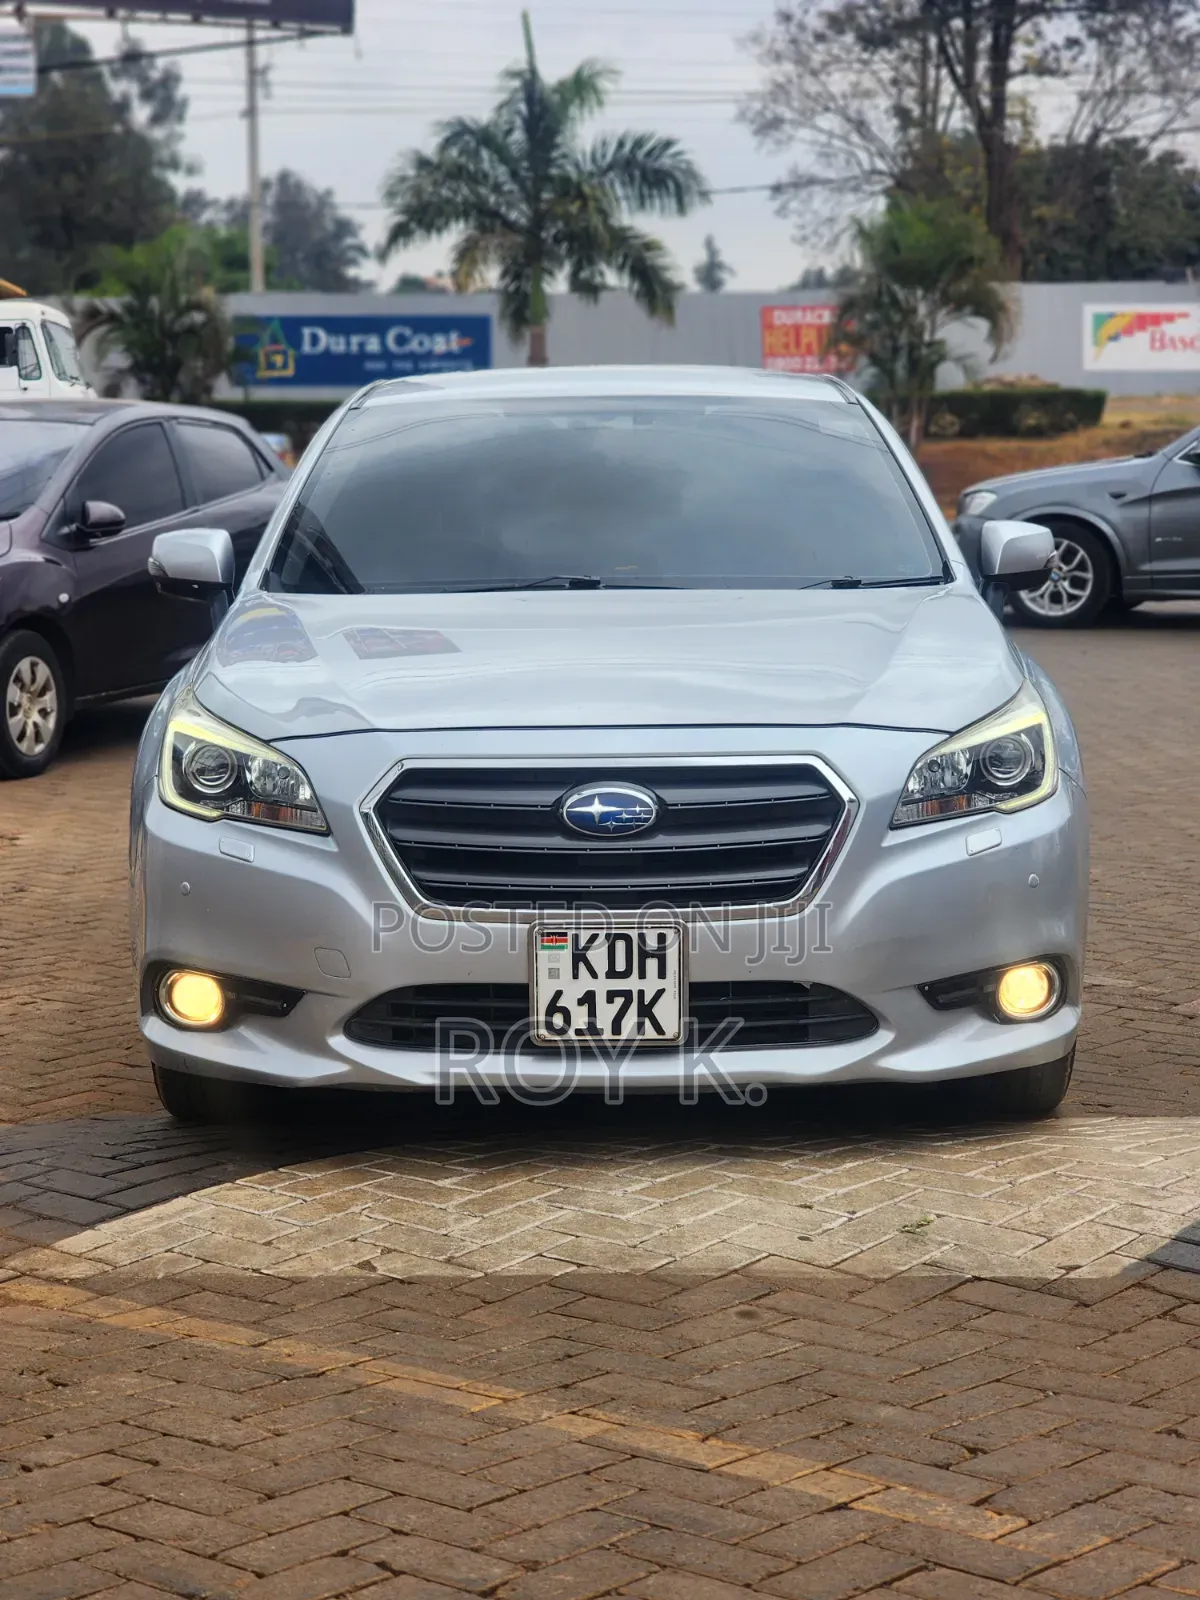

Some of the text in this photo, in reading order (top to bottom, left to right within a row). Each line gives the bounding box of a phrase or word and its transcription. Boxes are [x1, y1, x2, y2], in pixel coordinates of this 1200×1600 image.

[301, 325, 461, 355] Dura Coat
[571, 932, 667, 980] KDH
[544, 988, 667, 1036] 617K
